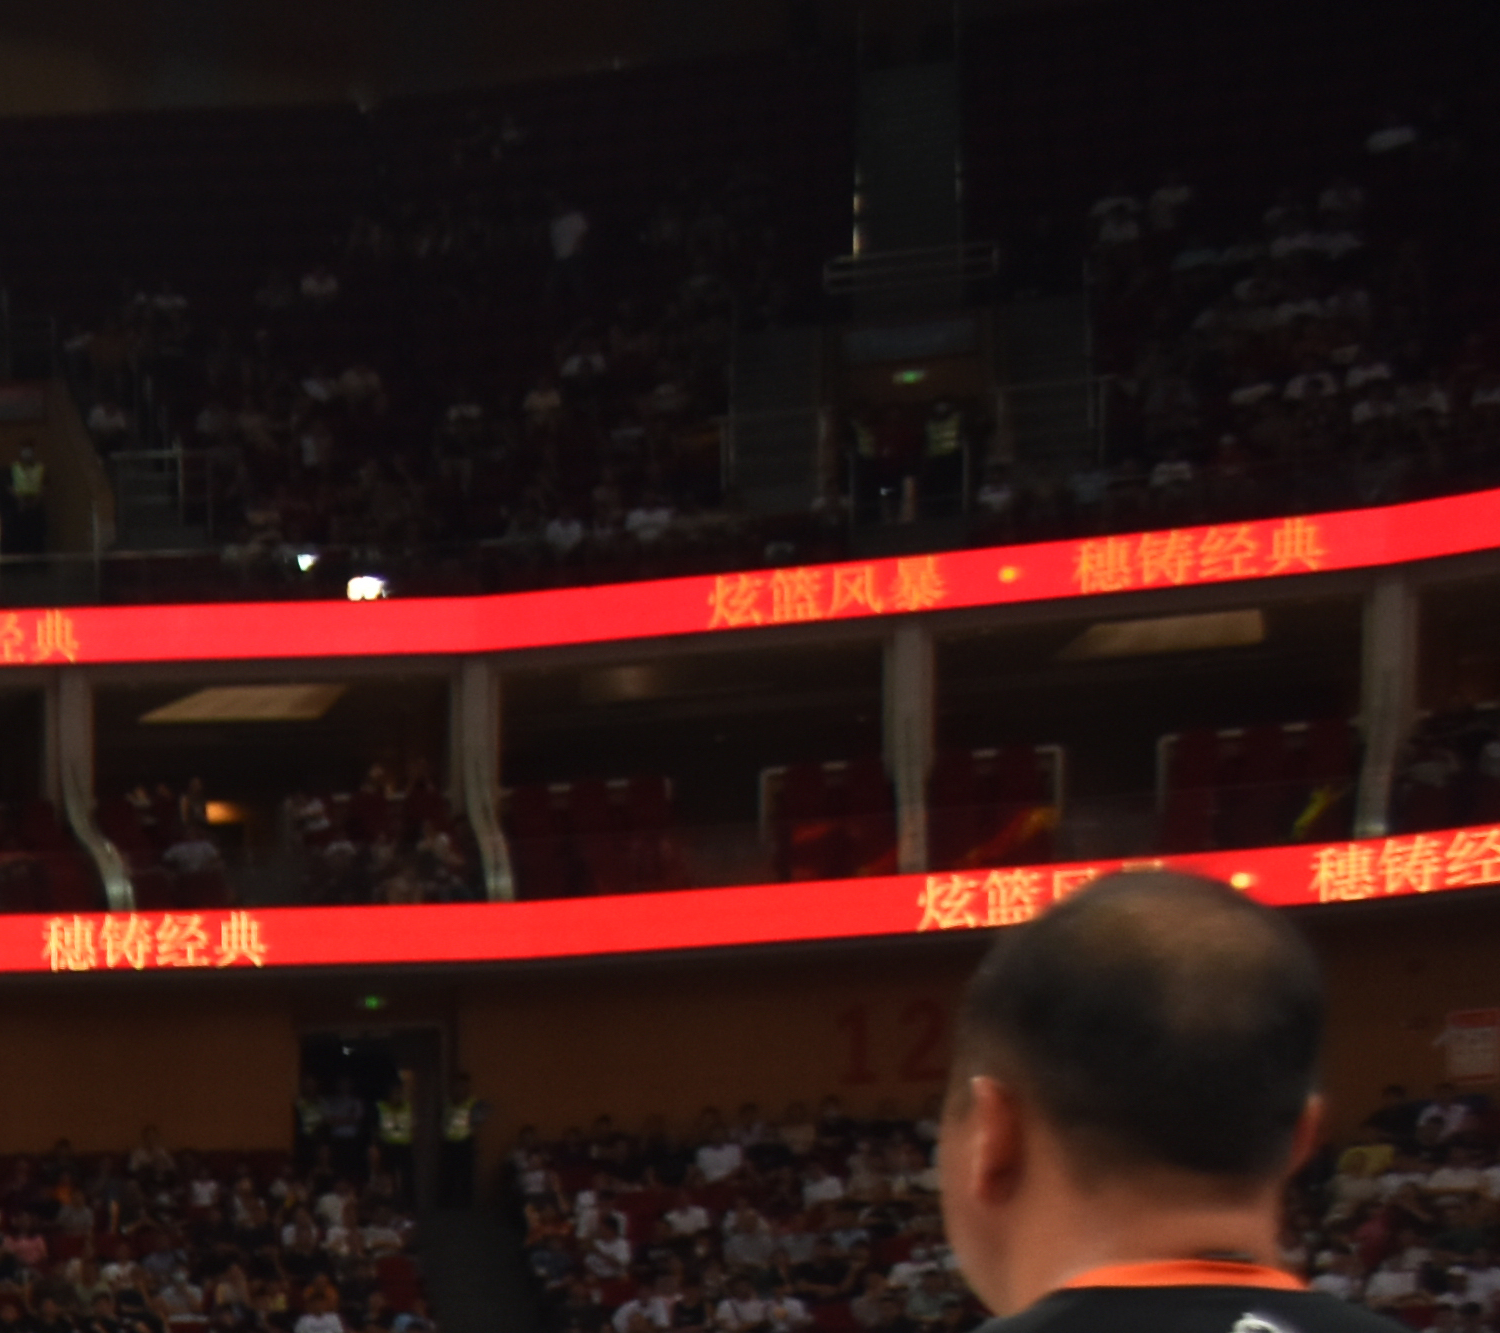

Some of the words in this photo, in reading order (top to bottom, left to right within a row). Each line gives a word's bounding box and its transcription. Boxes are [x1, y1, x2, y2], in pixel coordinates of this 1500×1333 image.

[705, 553, 948, 632] 炫篮风暴
[1071, 515, 1328, 594] 穗铸经典
[40, 908, 270, 974] 穗铸经典
